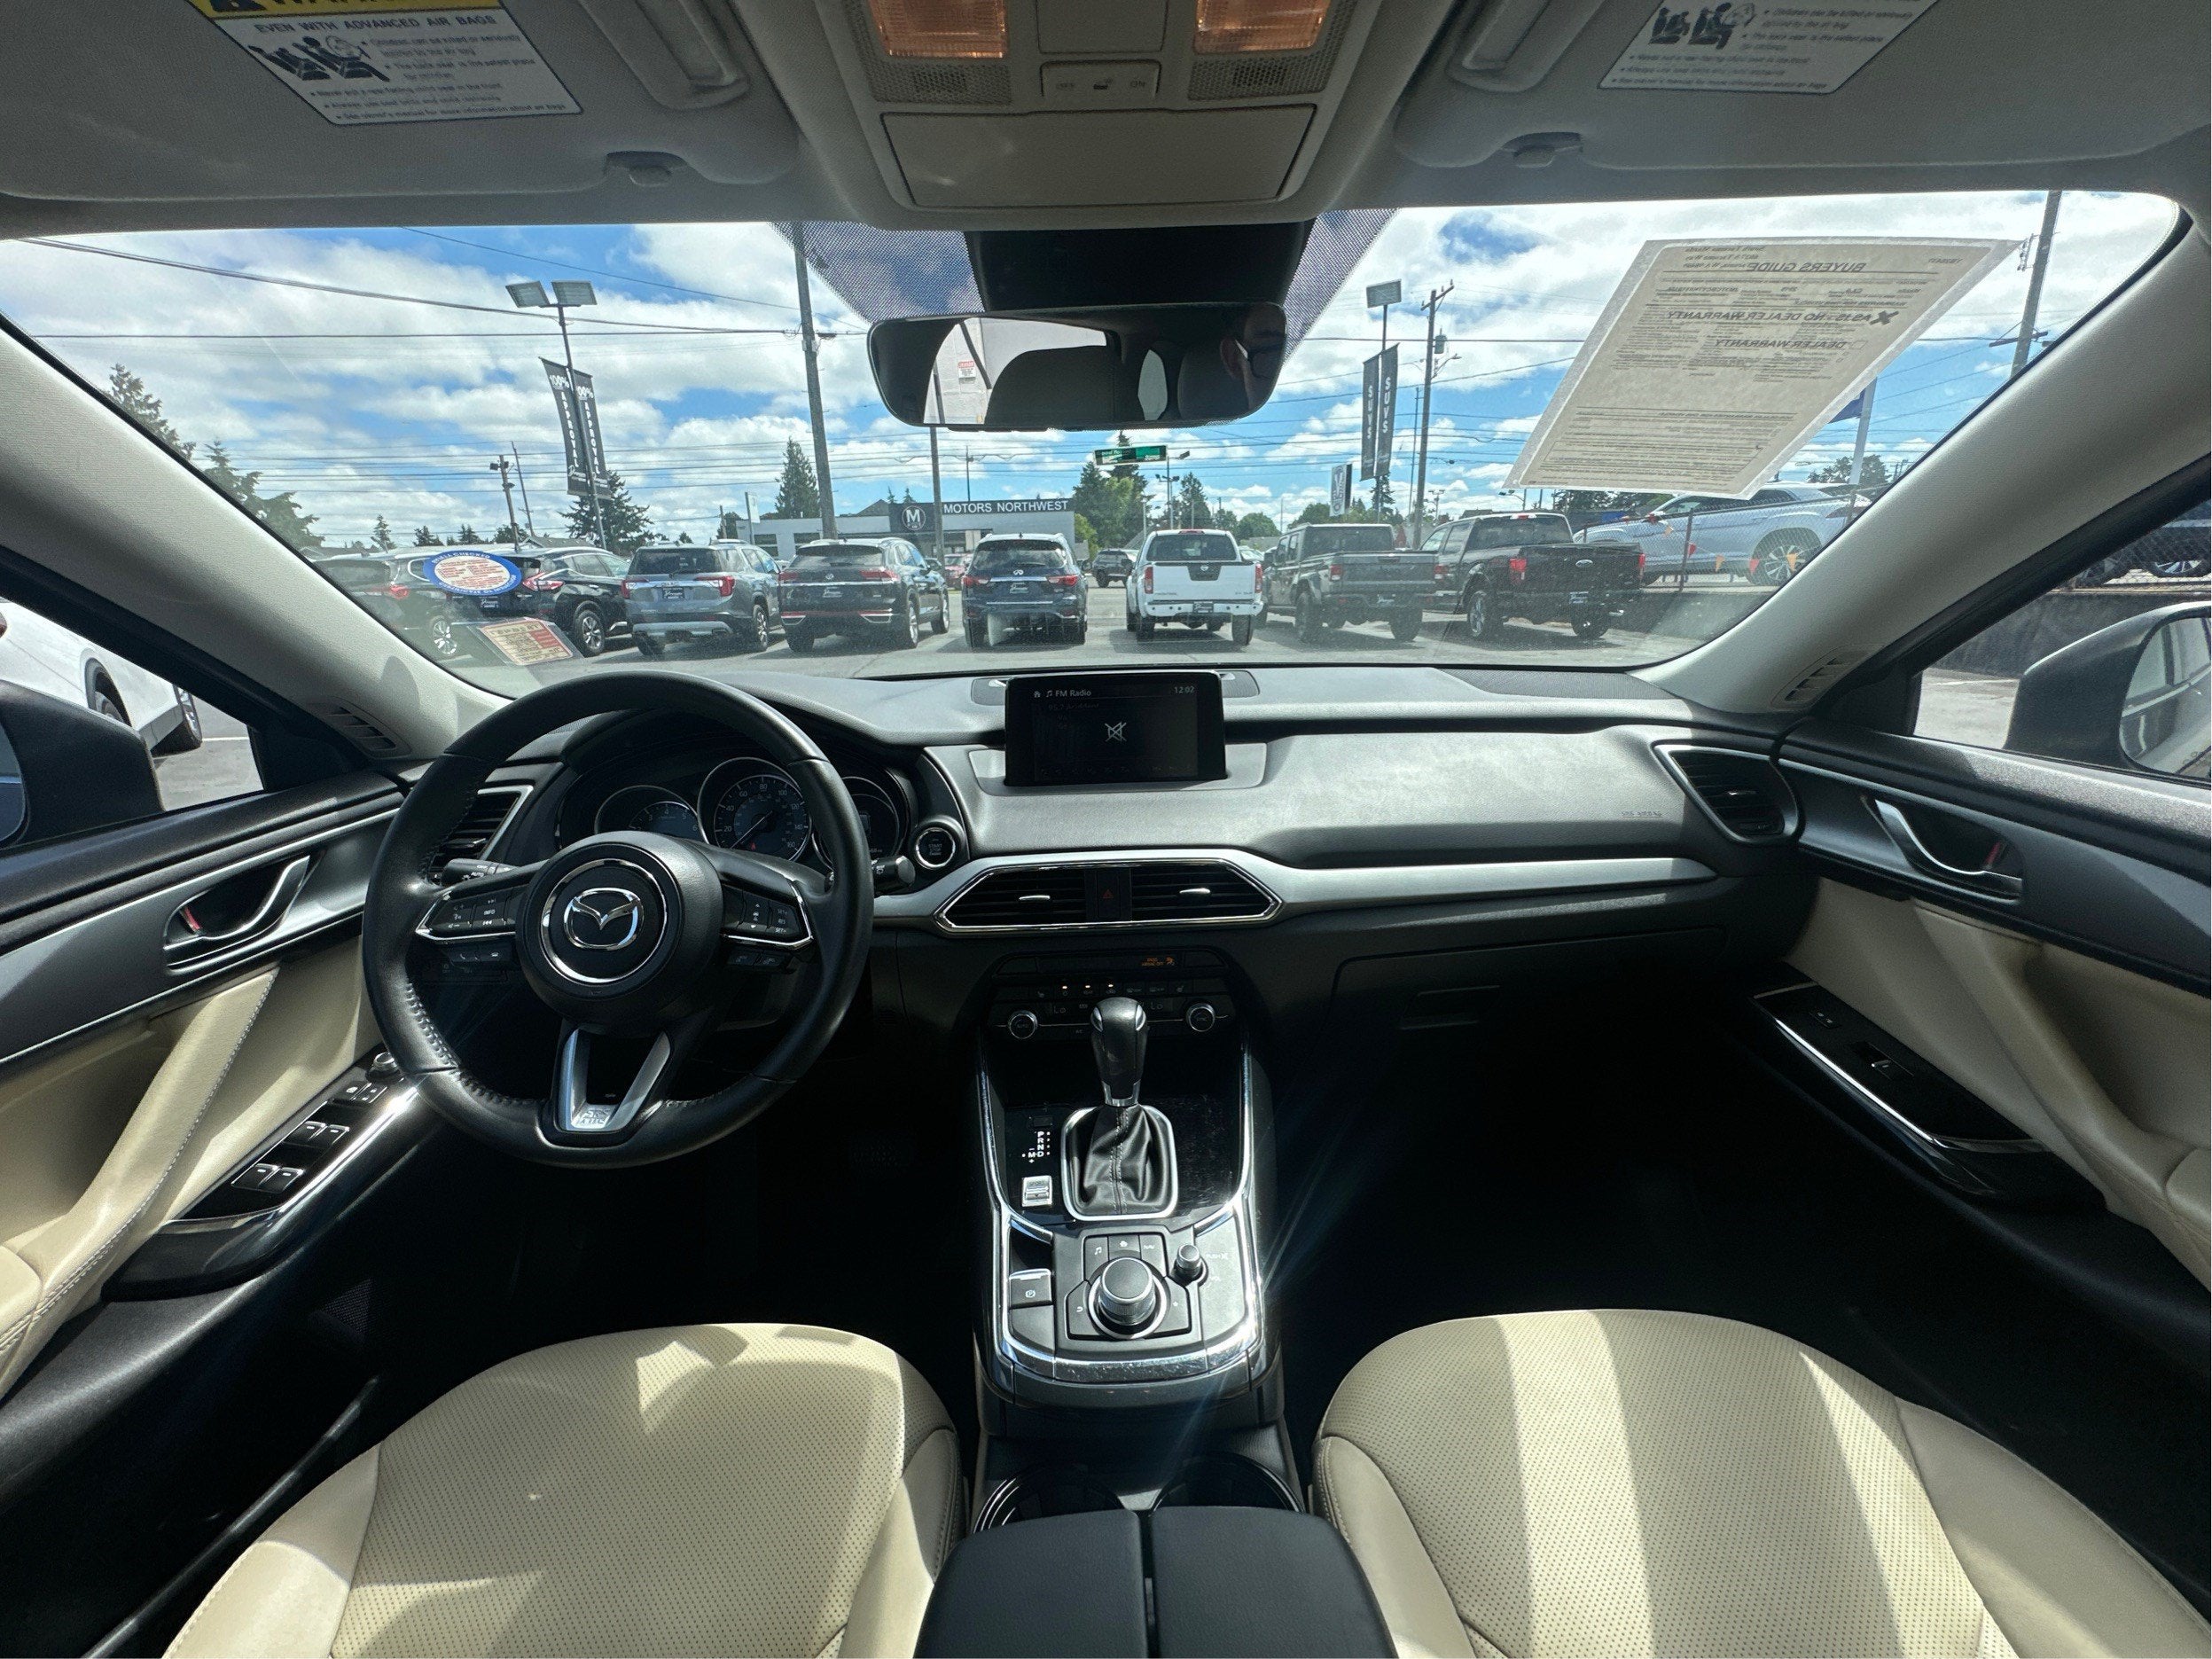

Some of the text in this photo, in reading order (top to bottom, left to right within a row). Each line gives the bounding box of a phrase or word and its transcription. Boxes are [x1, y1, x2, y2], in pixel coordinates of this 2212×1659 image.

[254, 14, 496, 34] EVEN WITH ADVANCED AIR BAGS
[549, 374, 570, 388] 100%
[559, 391, 580, 468] APPROVAL
[583, 402, 601, 475] APPROVAL
[943, 500, 1069, 514] MOTORS NORTHWEST
[906, 509, 921, 522] M
[1069, 689, 1092, 698] Radio
[1174, 685, 1195, 694] 12:02
[1054, 1006, 1067, 1014] Lo
